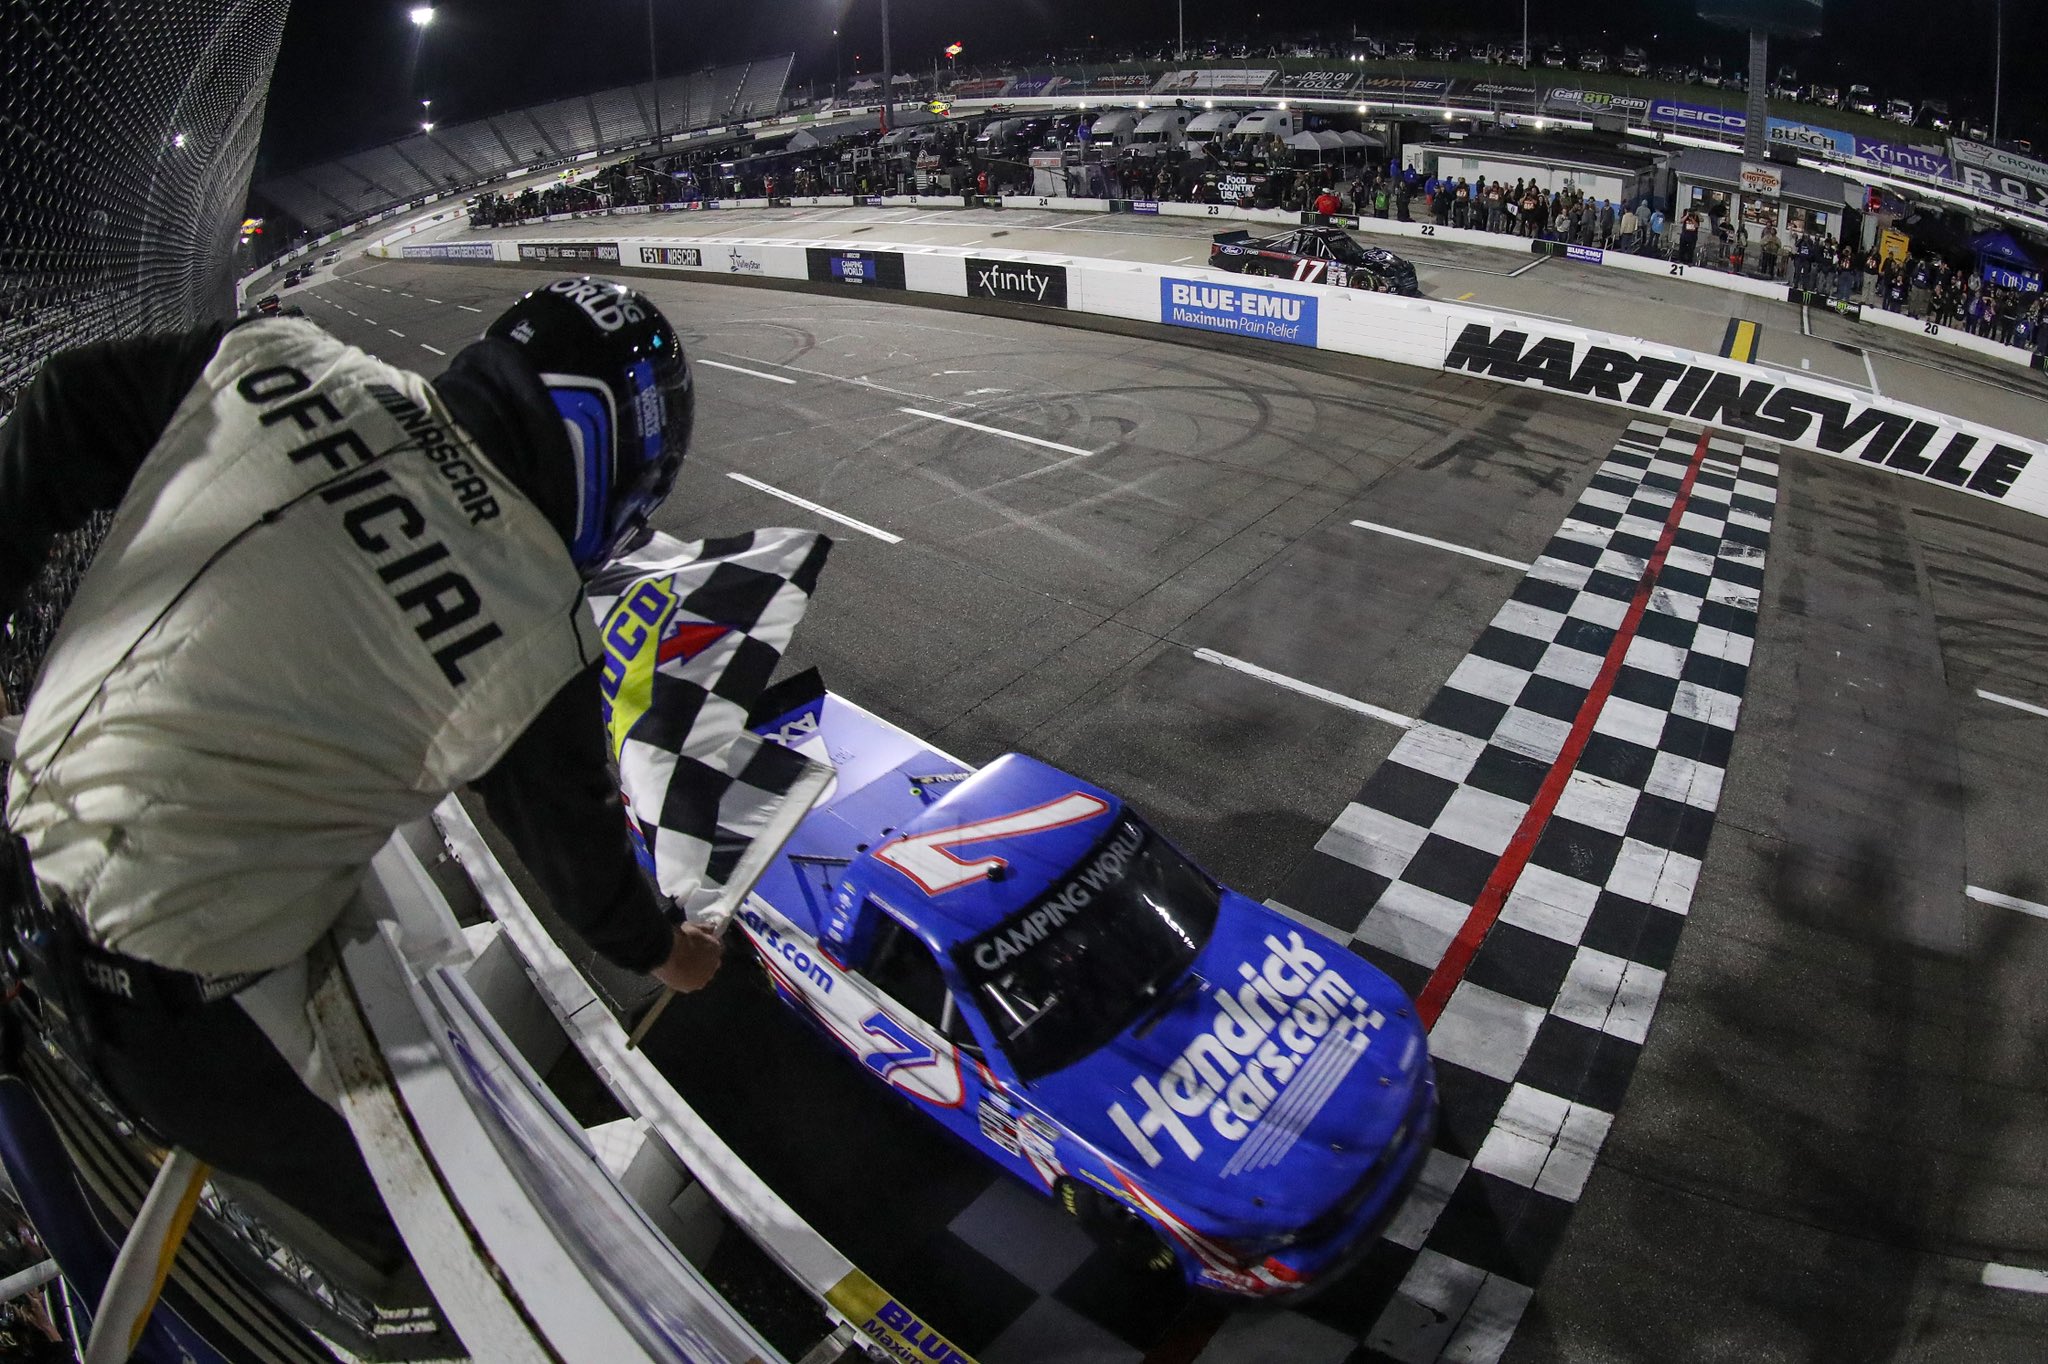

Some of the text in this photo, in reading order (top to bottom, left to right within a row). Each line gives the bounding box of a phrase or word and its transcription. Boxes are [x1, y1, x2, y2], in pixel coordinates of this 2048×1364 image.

[1296, 81, 1345, 89] TOOLS
[1302, 71, 1354, 81] DEAD ON
[1554, 90, 1645, 107] Call811.com
[1657, 106, 1746, 127] GEICO
[1771, 127, 1835, 151] BUSCH
[528, 155, 578, 172] MARTINSVILLE
[1860, 143, 1948, 175] xfinity
[1217, 182, 1257, 192] COUNTRY
[1226, 175, 1247, 184] FOOD
[1748, 183, 1773, 192] STND
[1039, 198, 1049, 206] 24
[1220, 191, 1241, 200] USA
[1207, 205, 1220, 215] 23
[1421, 224, 1435, 236] 22
[643, 247, 698, 266] FS1 NASCAR
[1567, 246, 1602, 258] BLUE-EMU
[841, 260, 863, 269] CAMPING
[842, 267, 864, 276] WORLD
[1293, 259, 1326, 283] 17
[1669, 264, 1684, 276] 21
[978, 264, 1049, 300] xfinity
[544, 279, 625, 331] ORLD
[1172, 283, 1301, 321] BLUE-EMU
[1173, 307, 1300, 340] Maximum Pain Relief
[1923, 321, 1939, 336] 20
[1444, 322, 2034, 498] MARTINSVILLE
[396, 408, 500, 527] NASCAR
[236, 365, 504, 689] OFFICIAL
[973, 885, 1092, 972] CAMPING
[1089, 826, 1145, 892] WORLD
[860, 1010, 938, 1081] 7
[1106, 930, 1327, 1169] Hendrick
[1209, 969, 1356, 1142] cars.com
